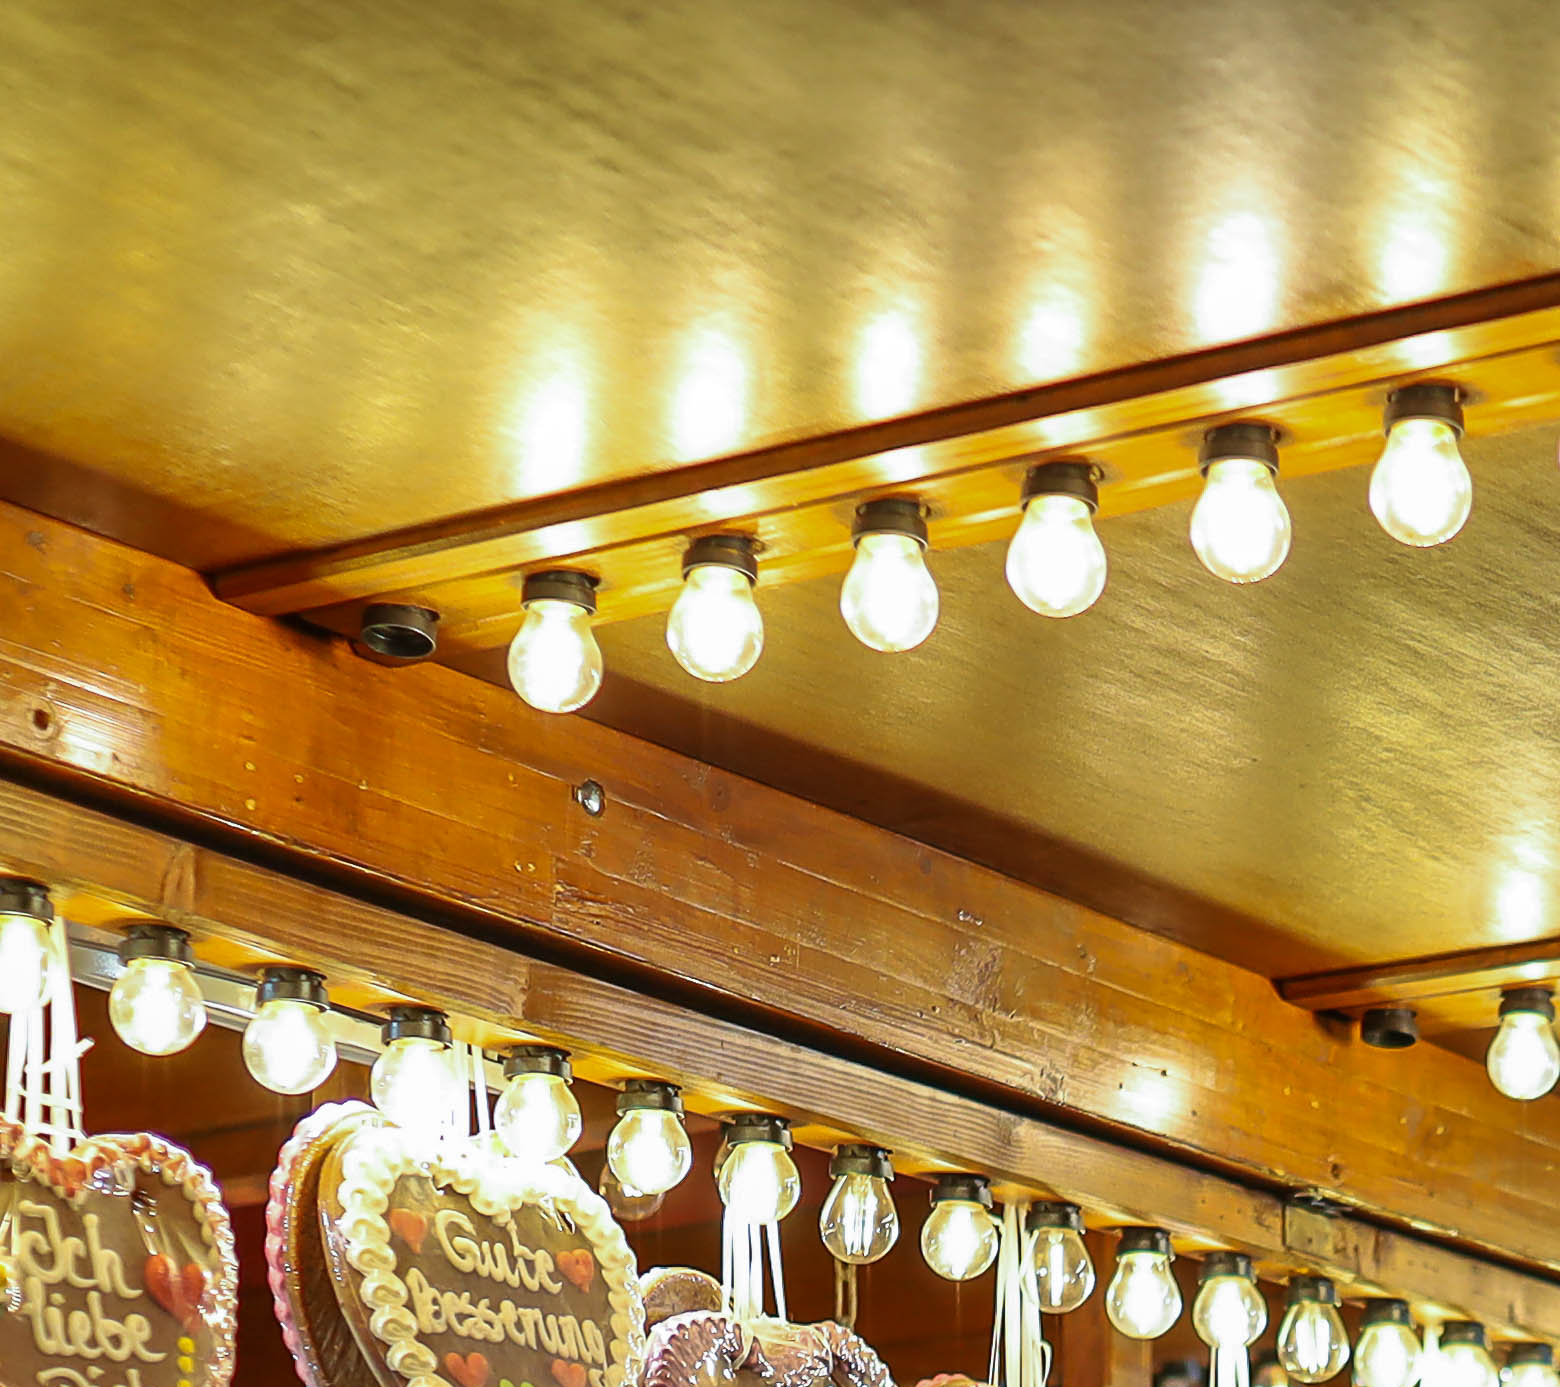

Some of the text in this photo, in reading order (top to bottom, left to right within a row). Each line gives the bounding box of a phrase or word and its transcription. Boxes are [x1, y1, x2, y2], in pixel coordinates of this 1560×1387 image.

[14, 1200, 138, 1300] Ich
[434, 1208, 562, 1295] Gute
[23, 1277, 167, 1365] liebe
